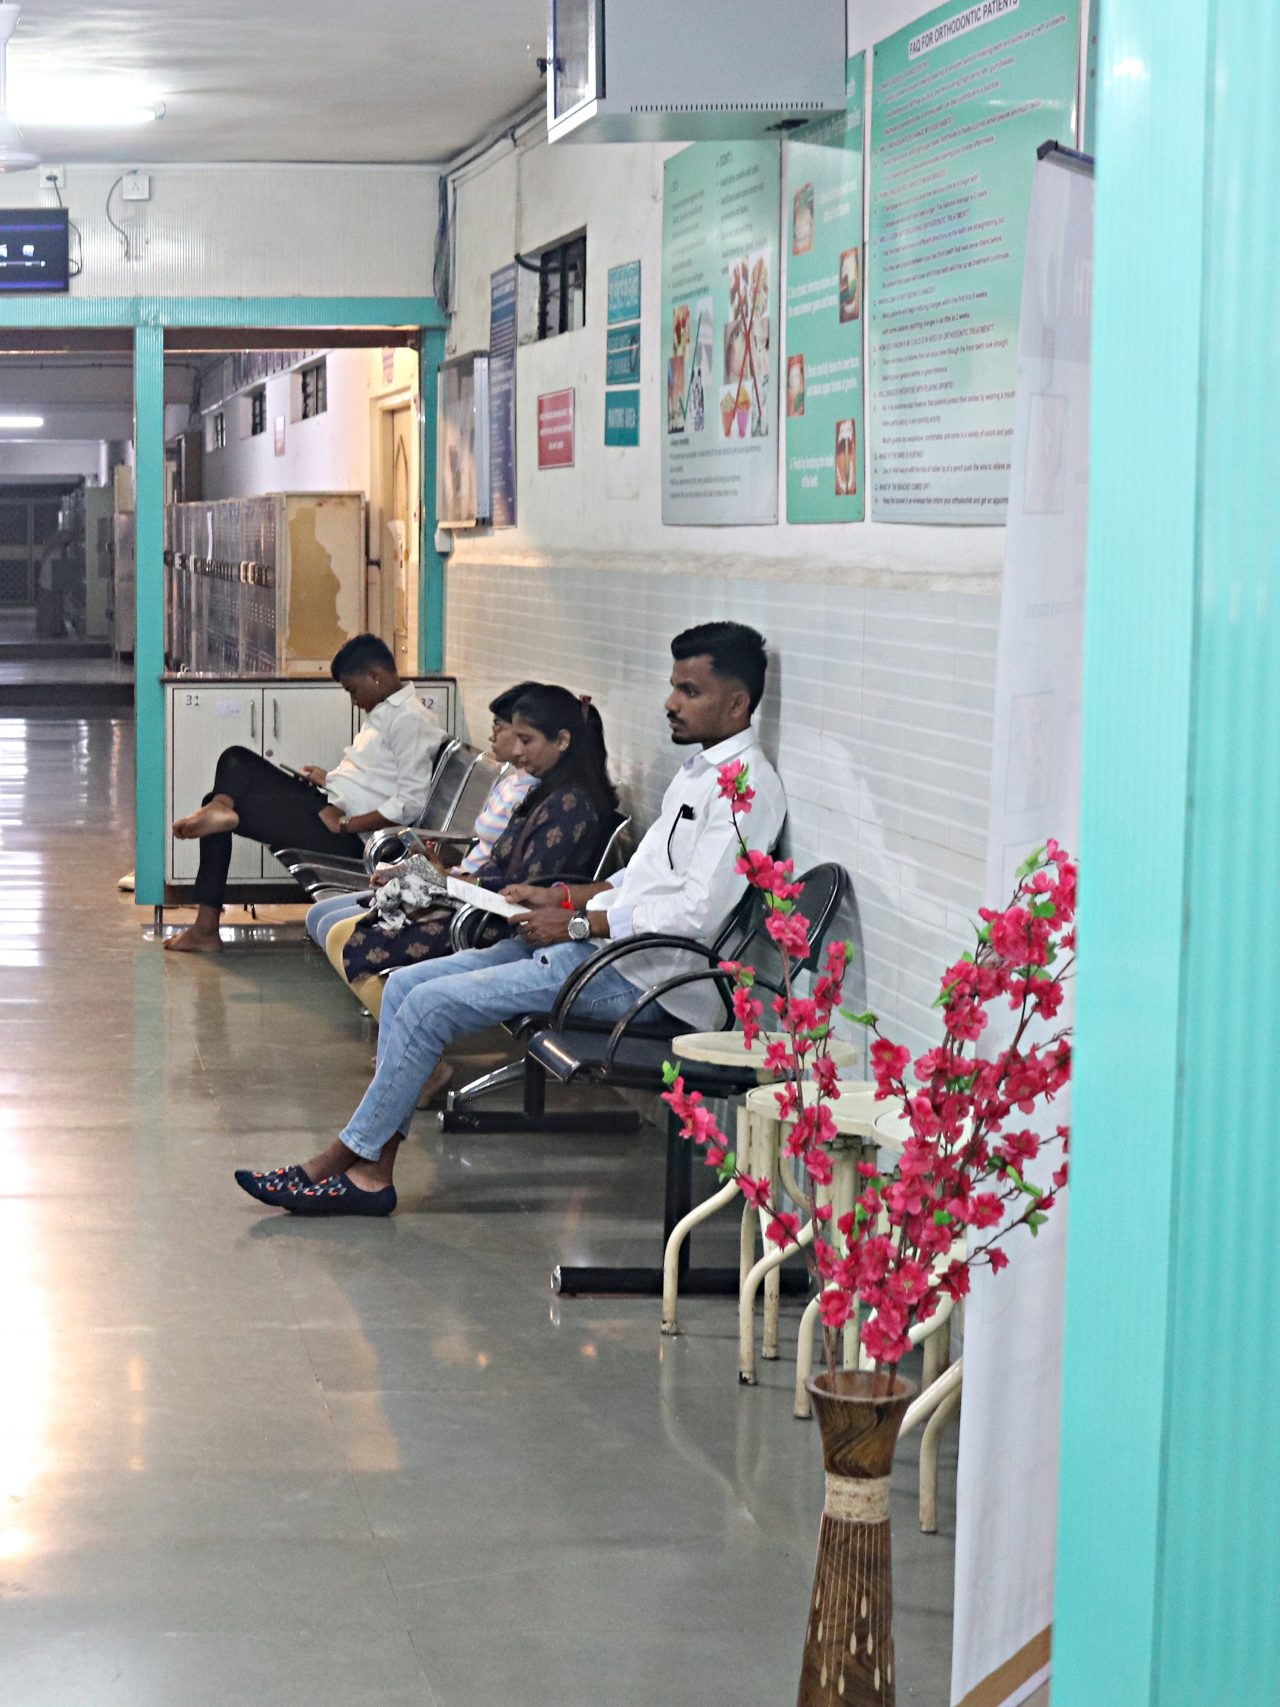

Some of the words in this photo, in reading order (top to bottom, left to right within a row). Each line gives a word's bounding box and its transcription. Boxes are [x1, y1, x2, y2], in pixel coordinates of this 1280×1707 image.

[909, 38, 920, 57] FAQ
[921, 31, 934, 50] FOR
[934, 6, 981, 42] ORTHODONTIC
[185, 694, 199, 706] 31
